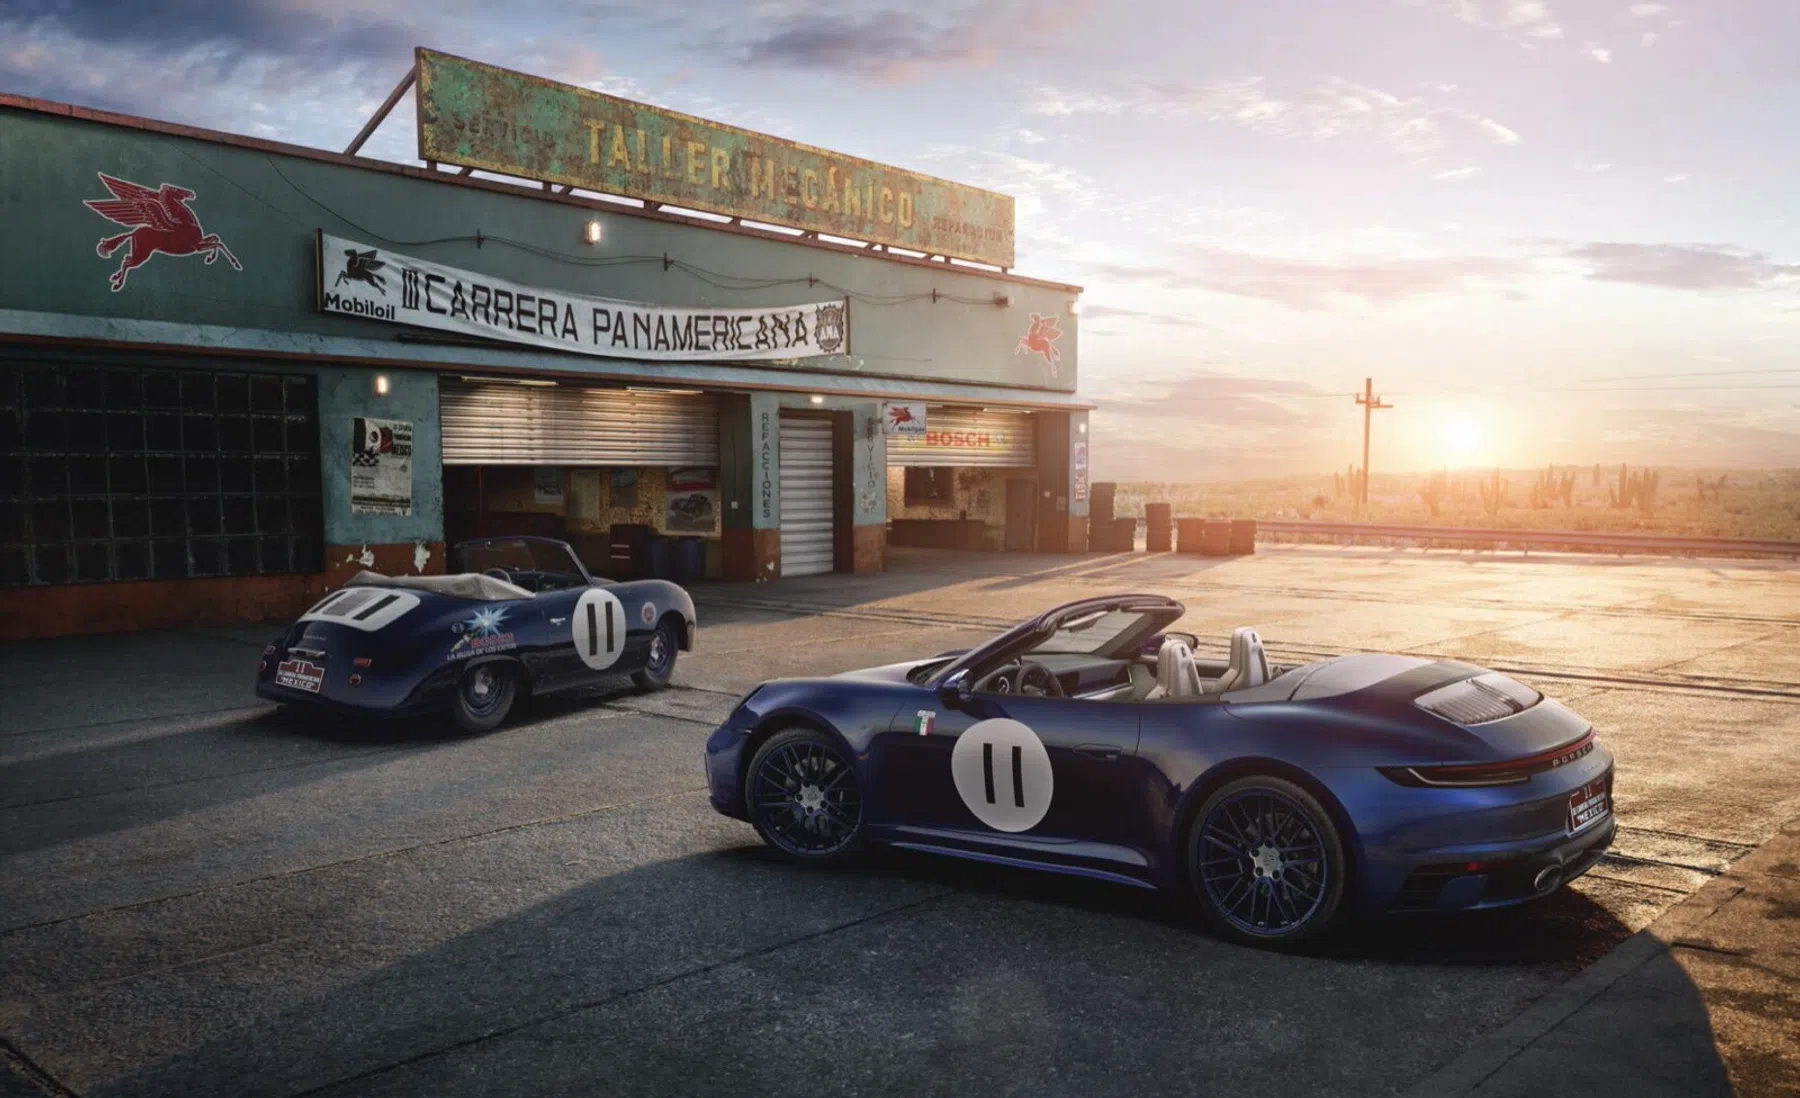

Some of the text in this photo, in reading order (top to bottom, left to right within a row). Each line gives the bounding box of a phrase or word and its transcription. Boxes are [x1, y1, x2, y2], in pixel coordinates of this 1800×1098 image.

[583, 118, 733, 192] TALLER
[324, 292, 395, 320] Mobiloil
[425, 273, 579, 342] CARRERA
[592, 307, 809, 351] PANAMERICANA
[761, 412, 772, 519] REFACCIONES
[926, 431, 990, 448] BOSCH
[586, 601, 615, 657] 11
[983, 743, 1025, 808] 11
